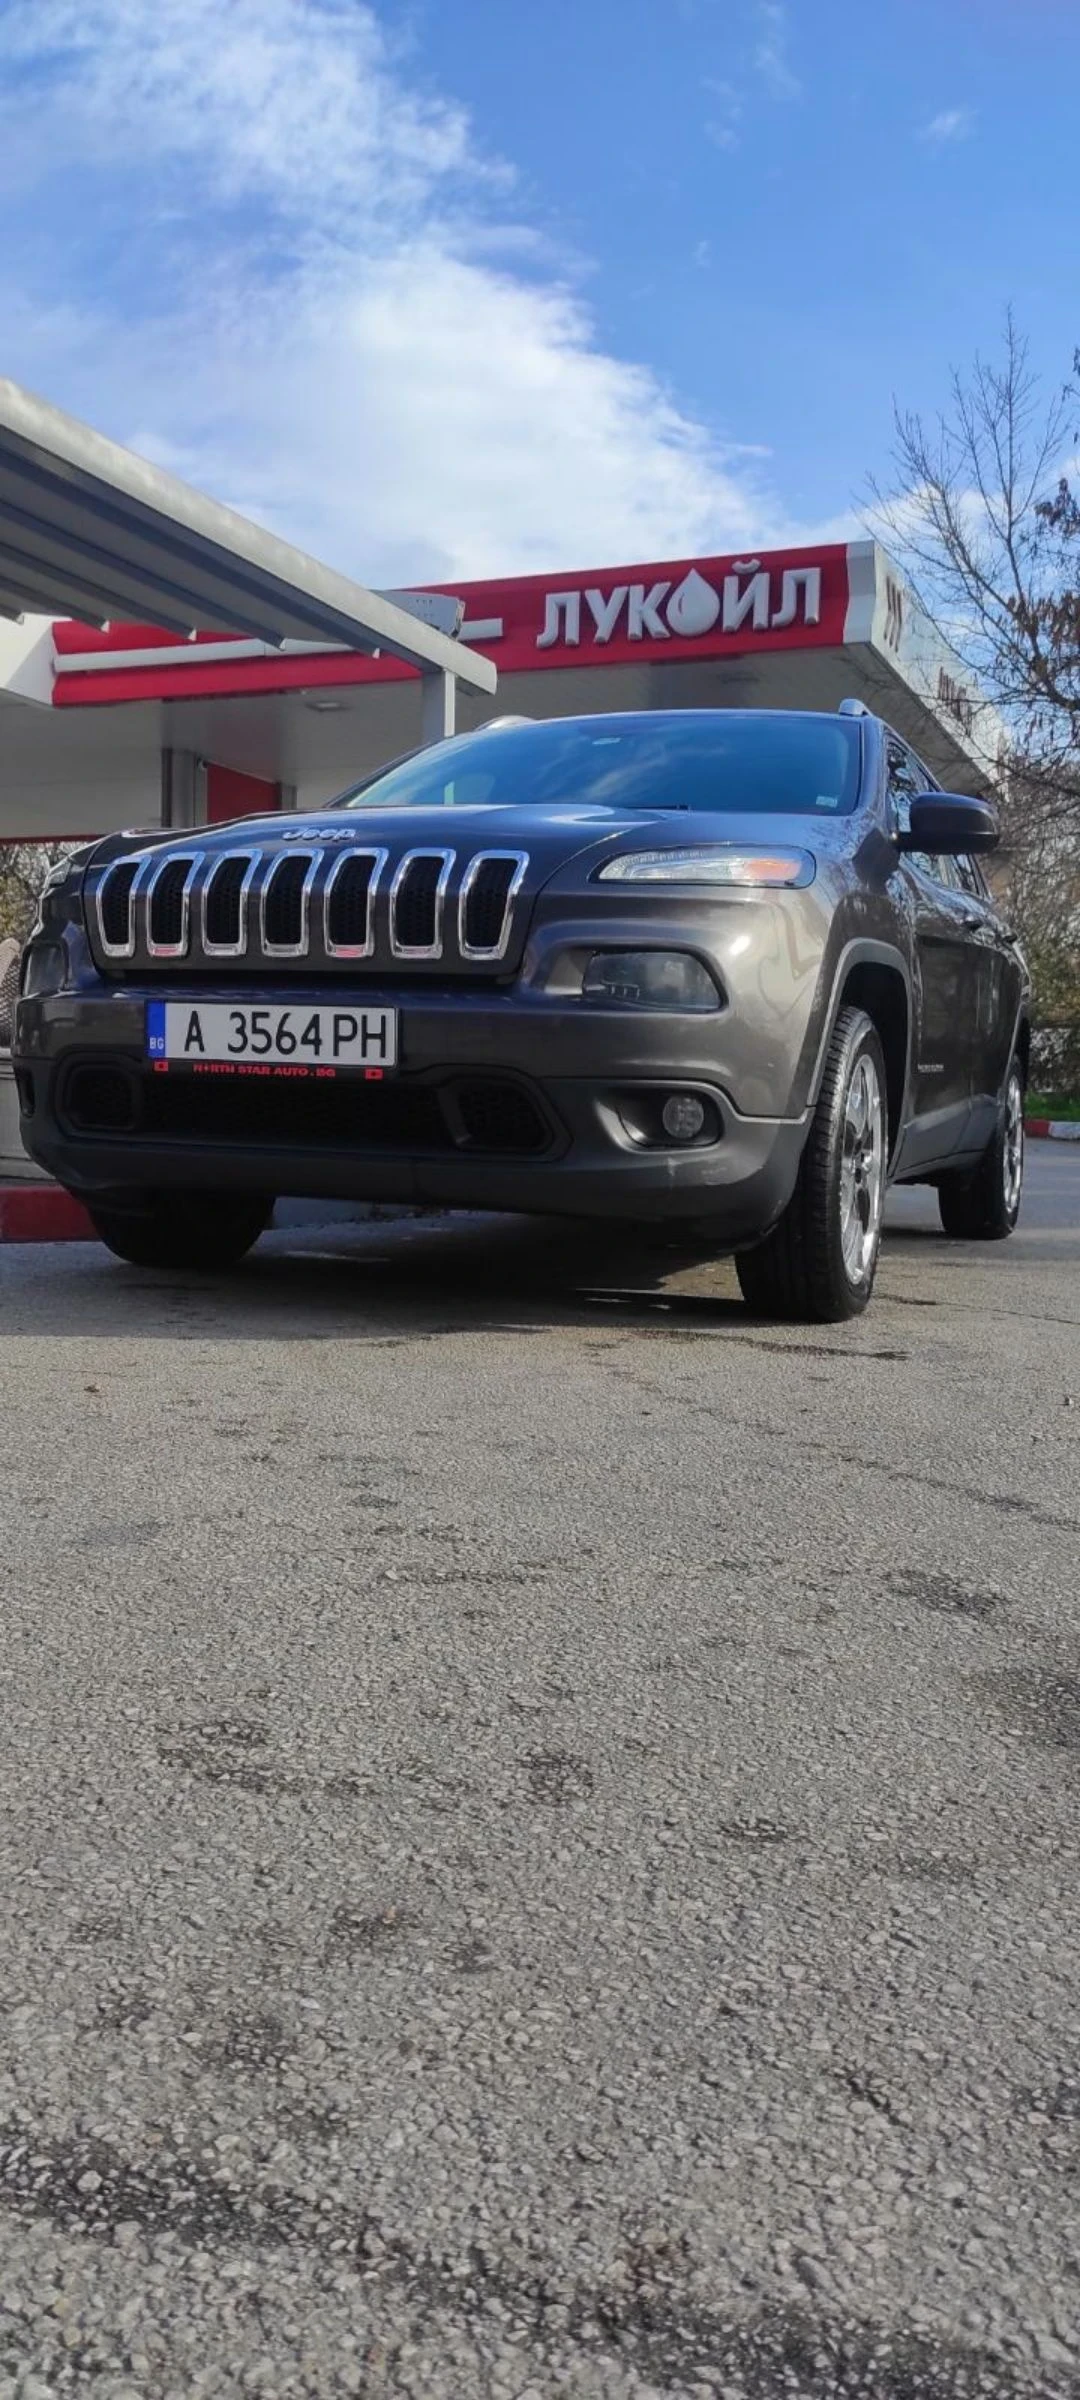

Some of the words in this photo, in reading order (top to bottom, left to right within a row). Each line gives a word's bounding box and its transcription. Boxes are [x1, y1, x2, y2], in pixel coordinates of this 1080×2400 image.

[537, 559, 821, 648] ЛУКОЙЛ
[282, 827, 356, 842] Jeep
[184, 1010, 205, 1052] A
[149, 1036, 164, 1050] BG
[238, 1064, 271, 1075] STAR
